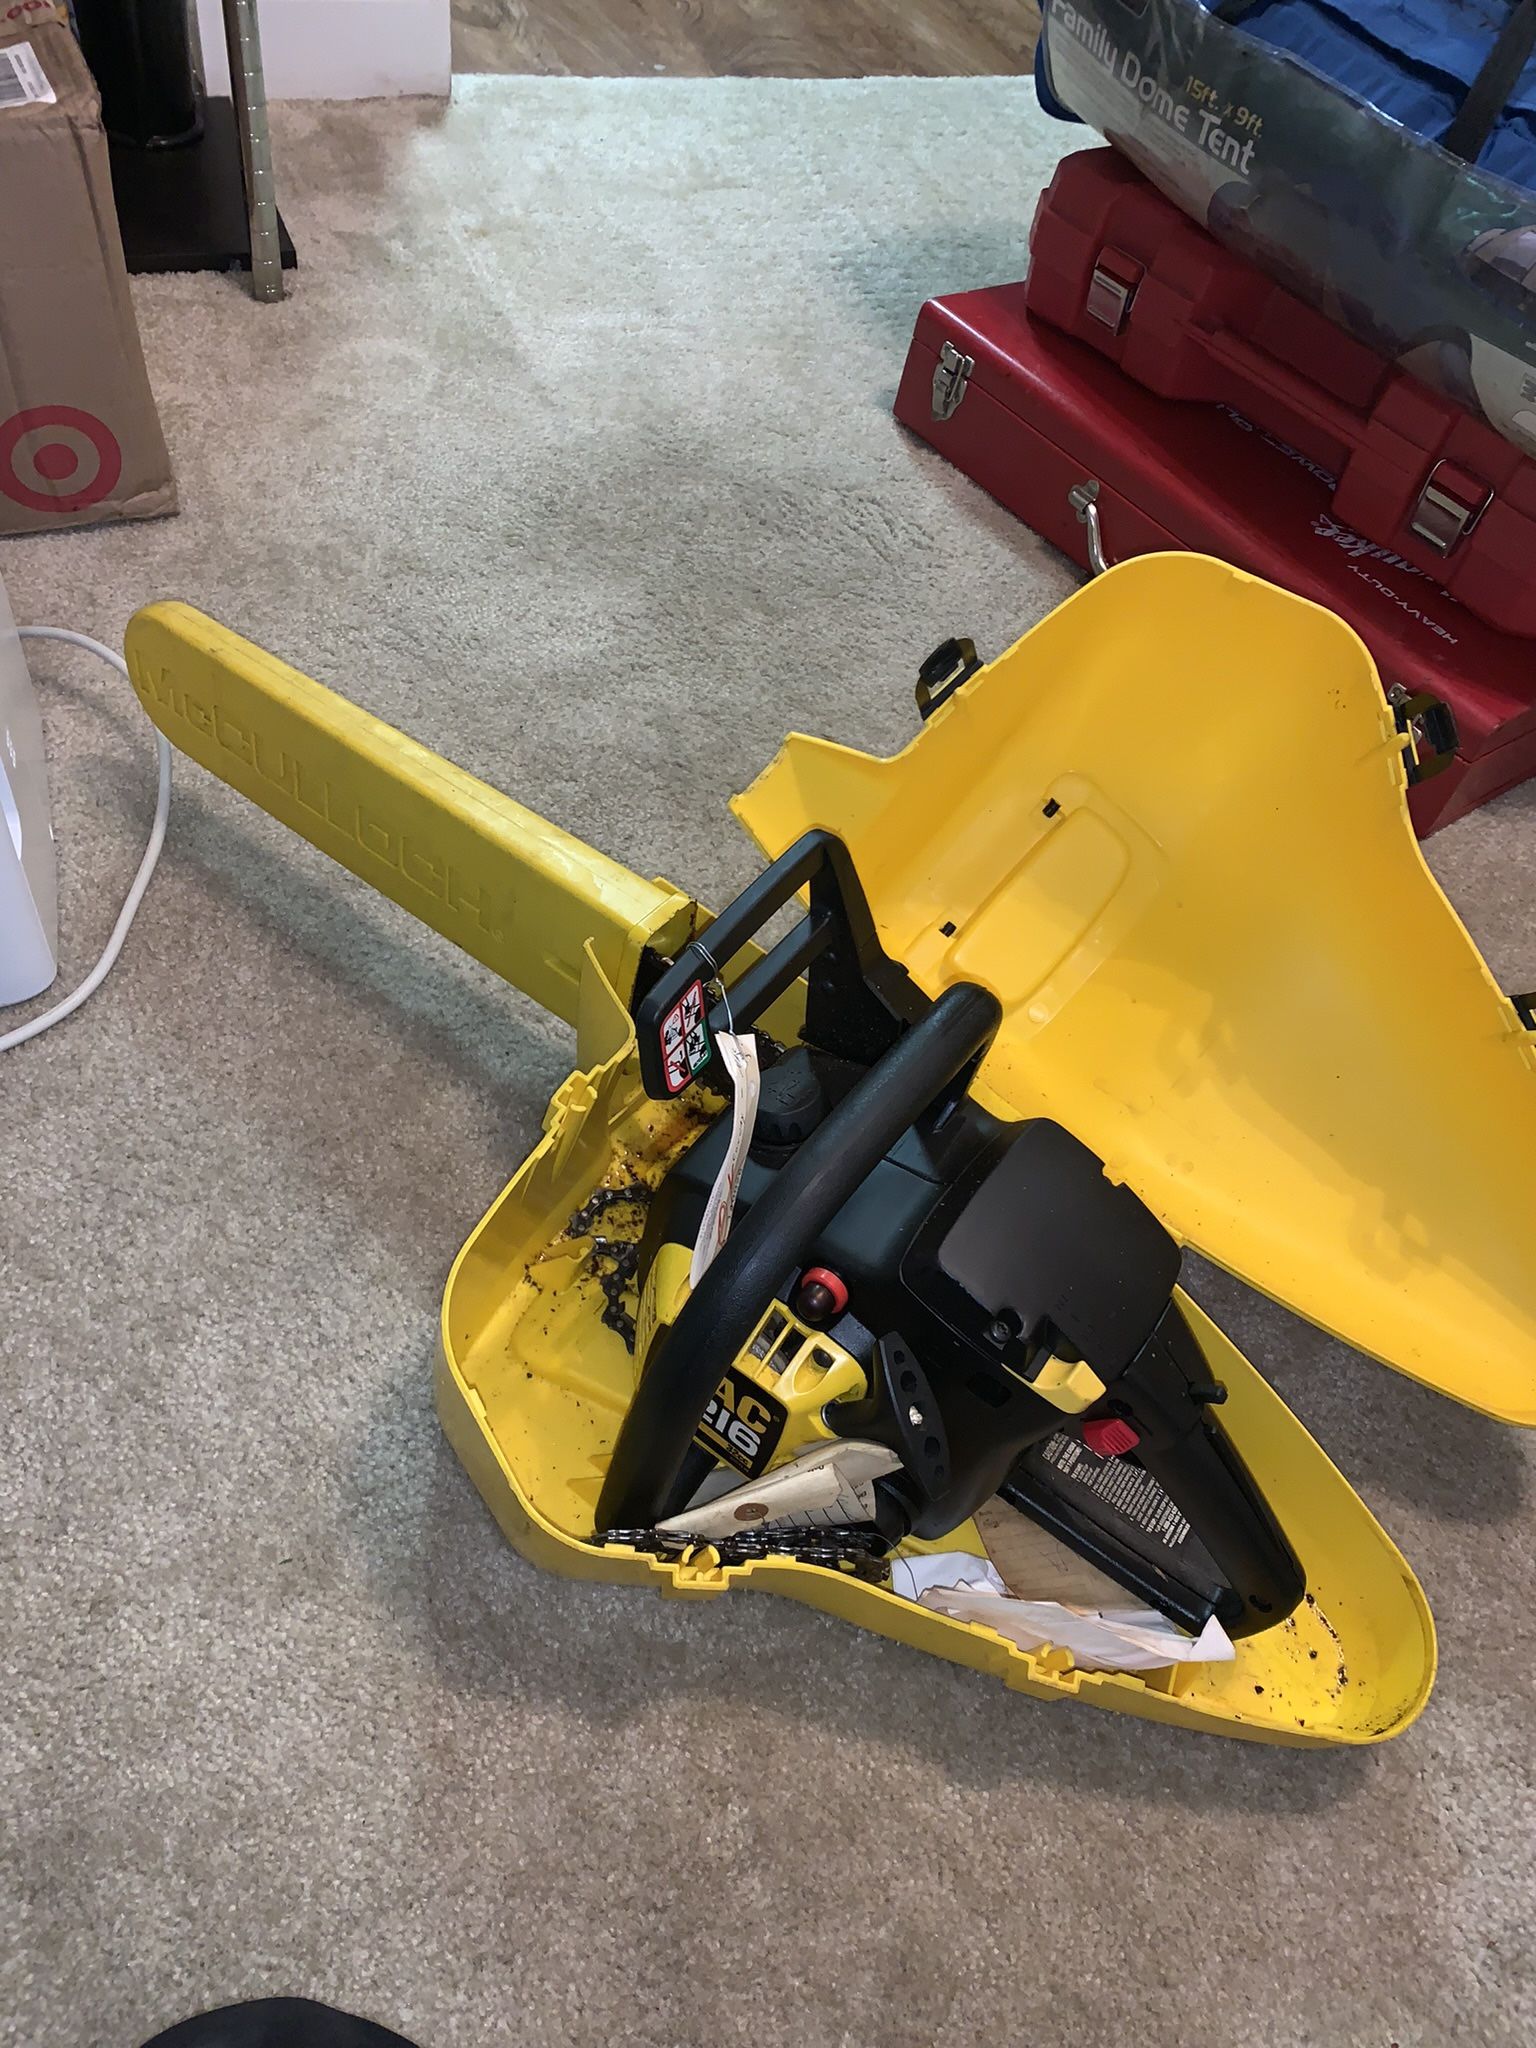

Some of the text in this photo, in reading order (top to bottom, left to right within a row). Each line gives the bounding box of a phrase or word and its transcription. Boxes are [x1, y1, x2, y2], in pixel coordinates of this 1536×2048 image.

[1120, 50, 1190, 133] Dome
[1198, 108, 1255, 176] Tent
[1186, 75, 1218, 110] 15ft.
[1233, 106, 1263, 138] 9ft.
[1347, 564, 1459, 645] HEAVY-DUTY
[714, 1376, 773, 1435] AC
